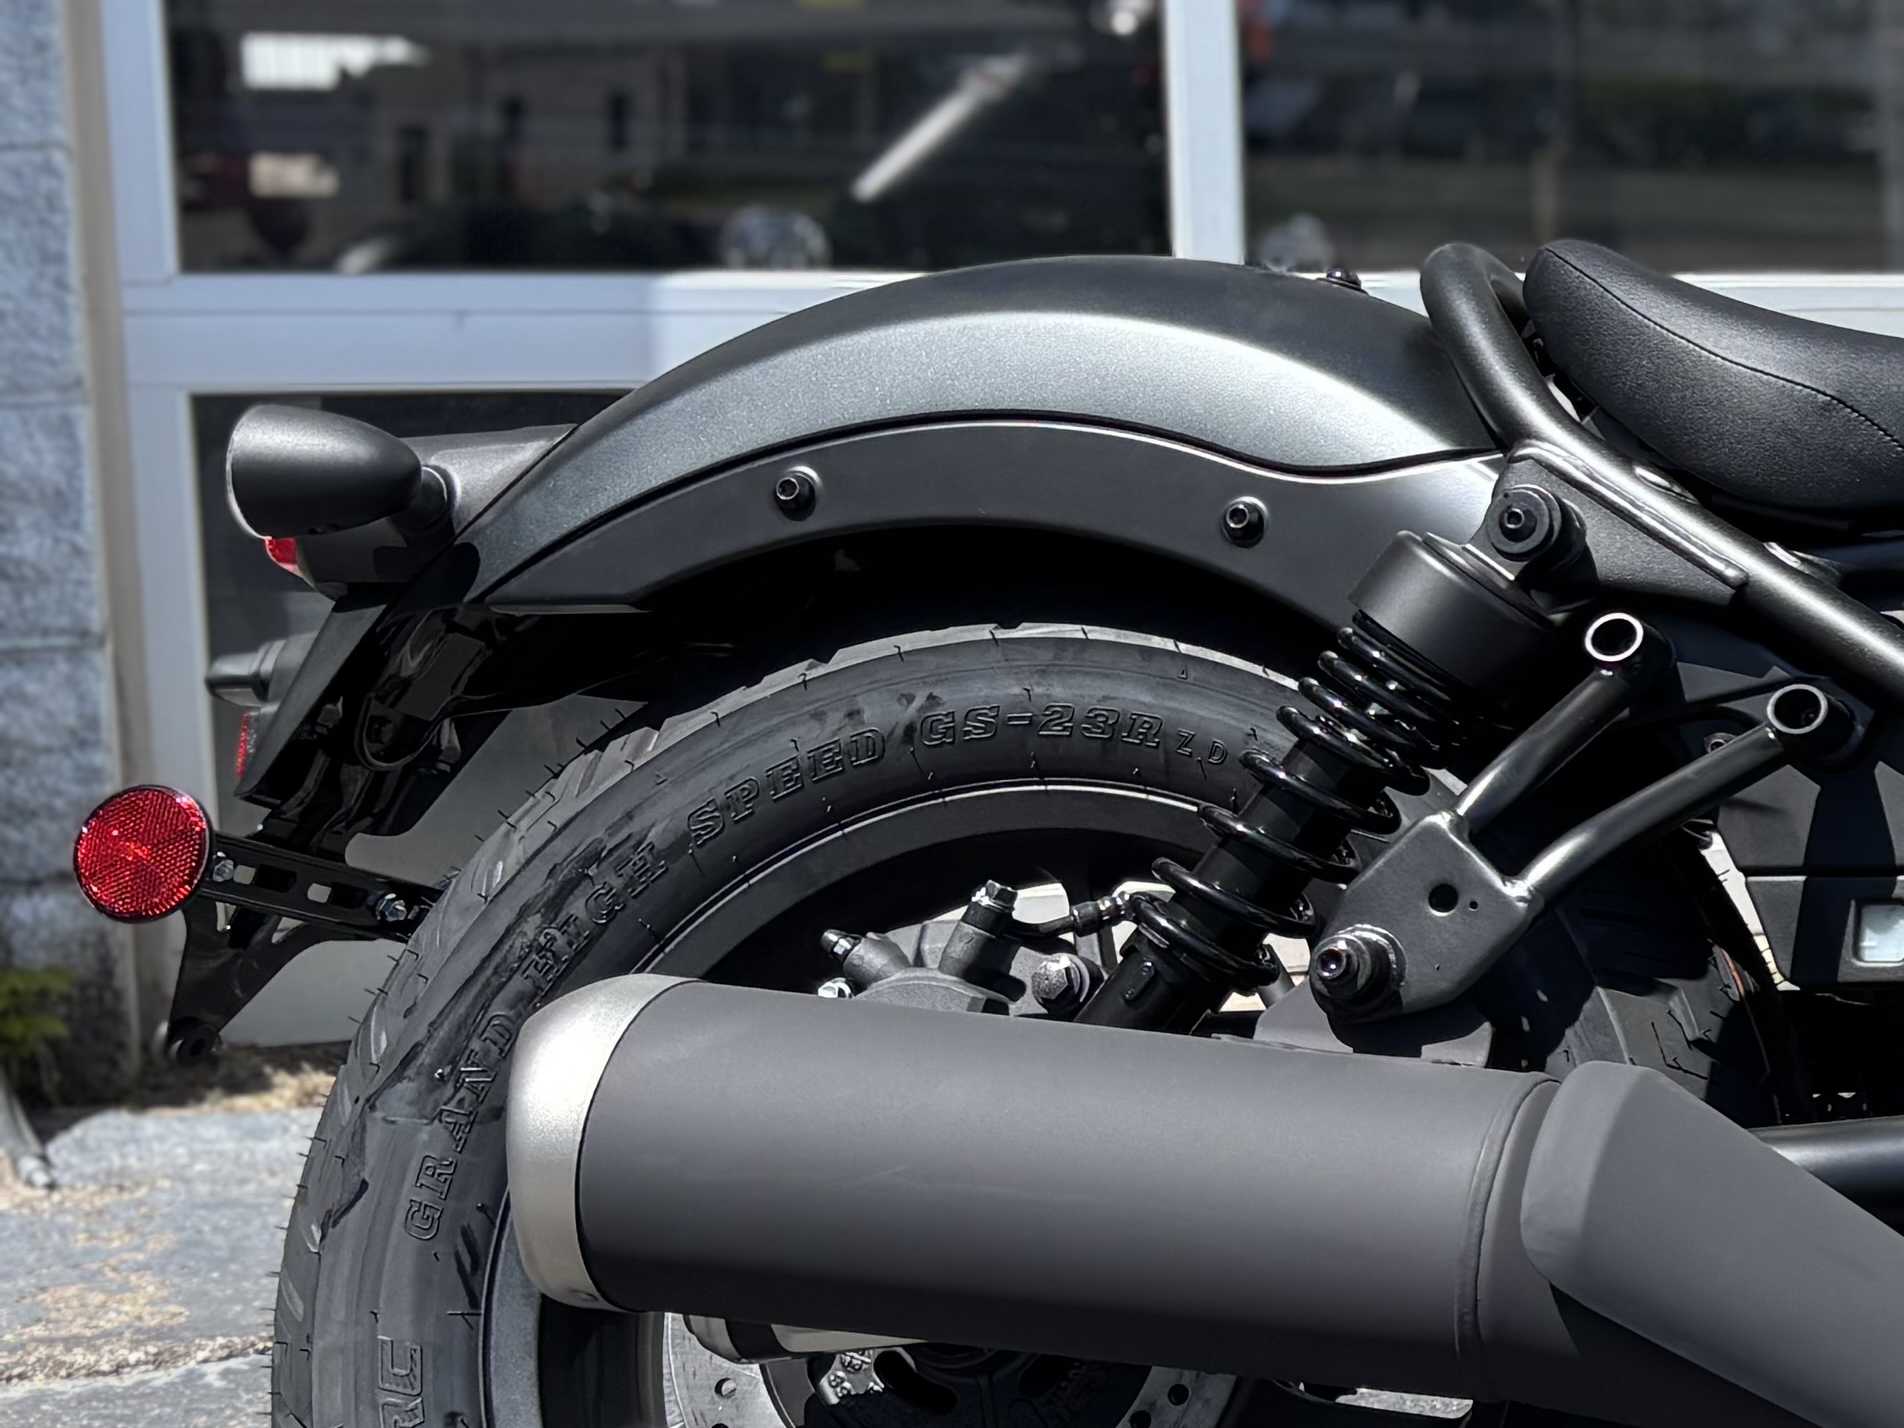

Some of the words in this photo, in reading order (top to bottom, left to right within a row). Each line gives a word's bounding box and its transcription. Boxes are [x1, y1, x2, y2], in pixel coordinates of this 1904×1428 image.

[404, 1009, 520, 1242] GRAND
[522, 844, 668, 994] HIGH
[686, 726, 887, 845] SPEED
[920, 703, 1166, 749] GS-23R
